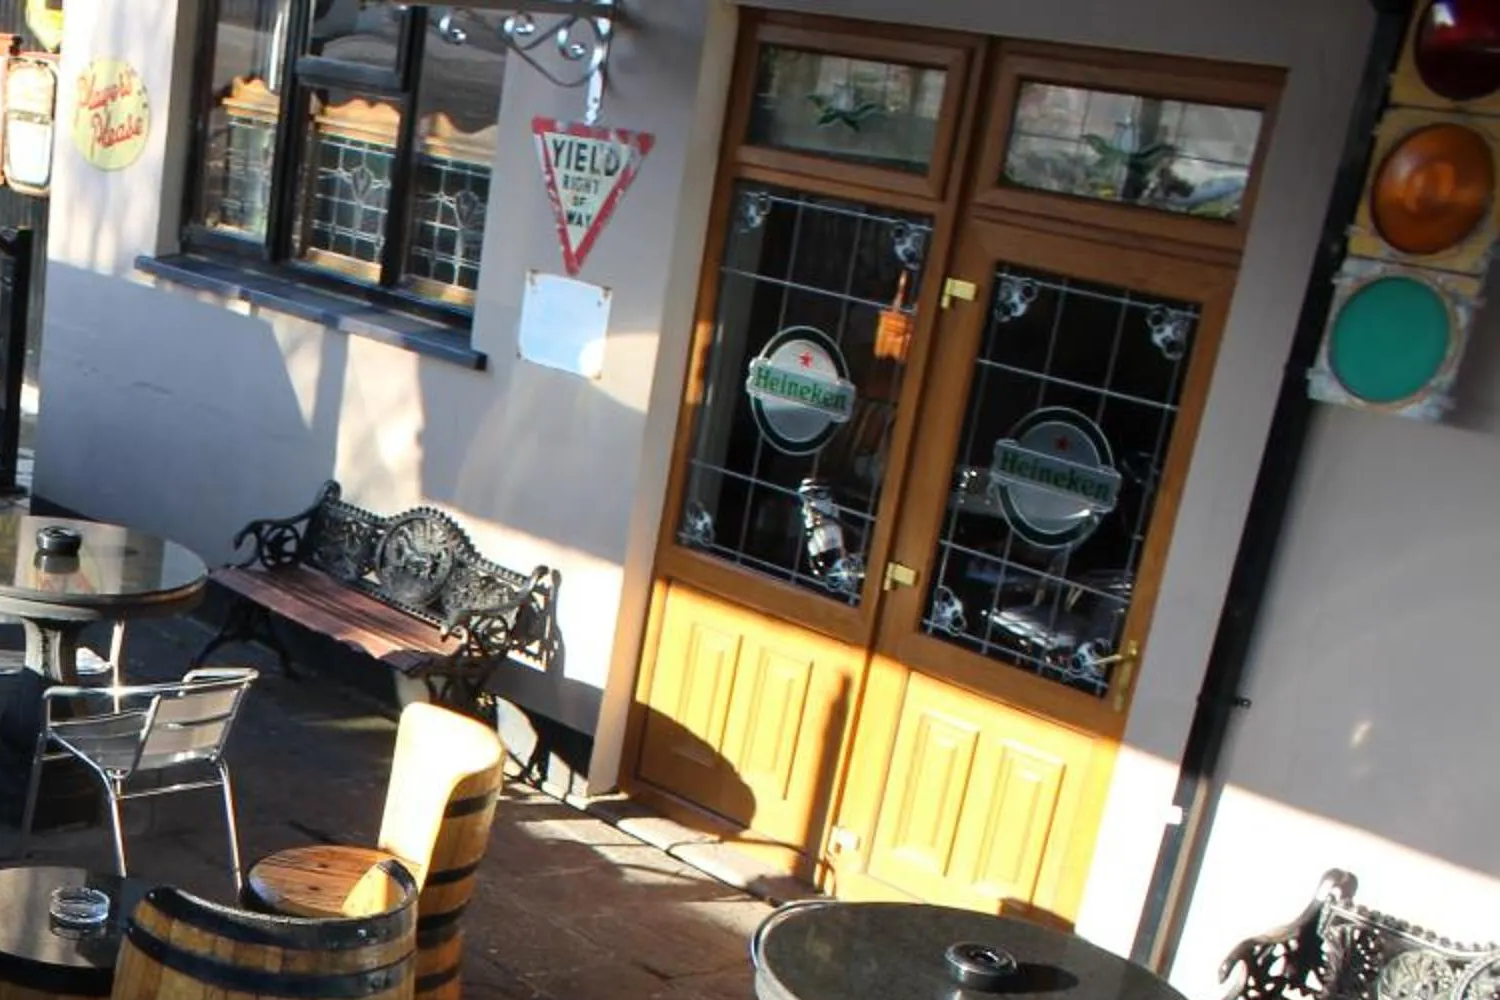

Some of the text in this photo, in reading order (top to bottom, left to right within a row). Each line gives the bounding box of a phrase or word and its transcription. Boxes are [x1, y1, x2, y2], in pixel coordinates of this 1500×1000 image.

[552, 138, 619, 177] YIELD
[566, 209, 592, 227] WAY
[755, 365, 848, 411] Heineken
[1001, 447, 1111, 504] Heineken
